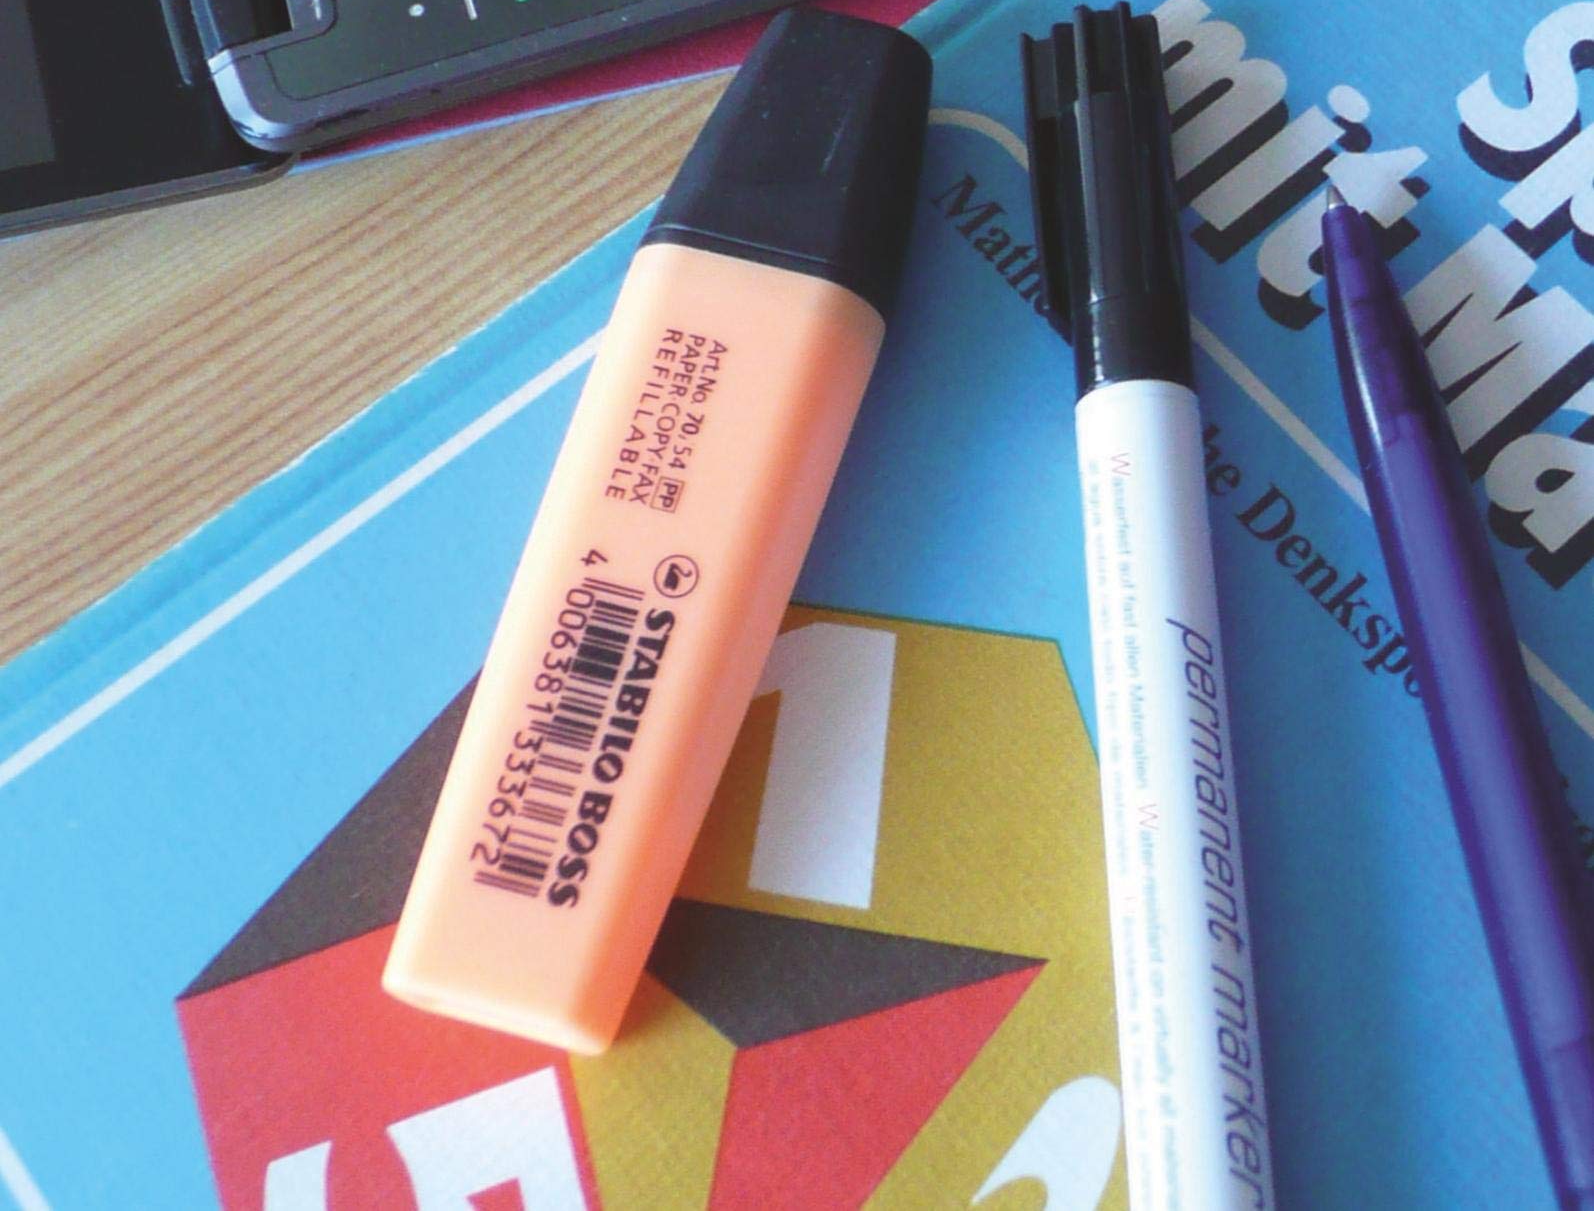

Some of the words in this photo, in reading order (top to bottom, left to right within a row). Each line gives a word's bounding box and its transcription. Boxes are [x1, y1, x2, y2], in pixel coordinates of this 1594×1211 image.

[604, 327, 684, 503] REFILLABLE
[591, 607, 677, 784] STABILO
[546, 789, 614, 909] BOSS
[1164, 617, 1246, 955] permanent
[1210, 963, 1268, 1211] marker
